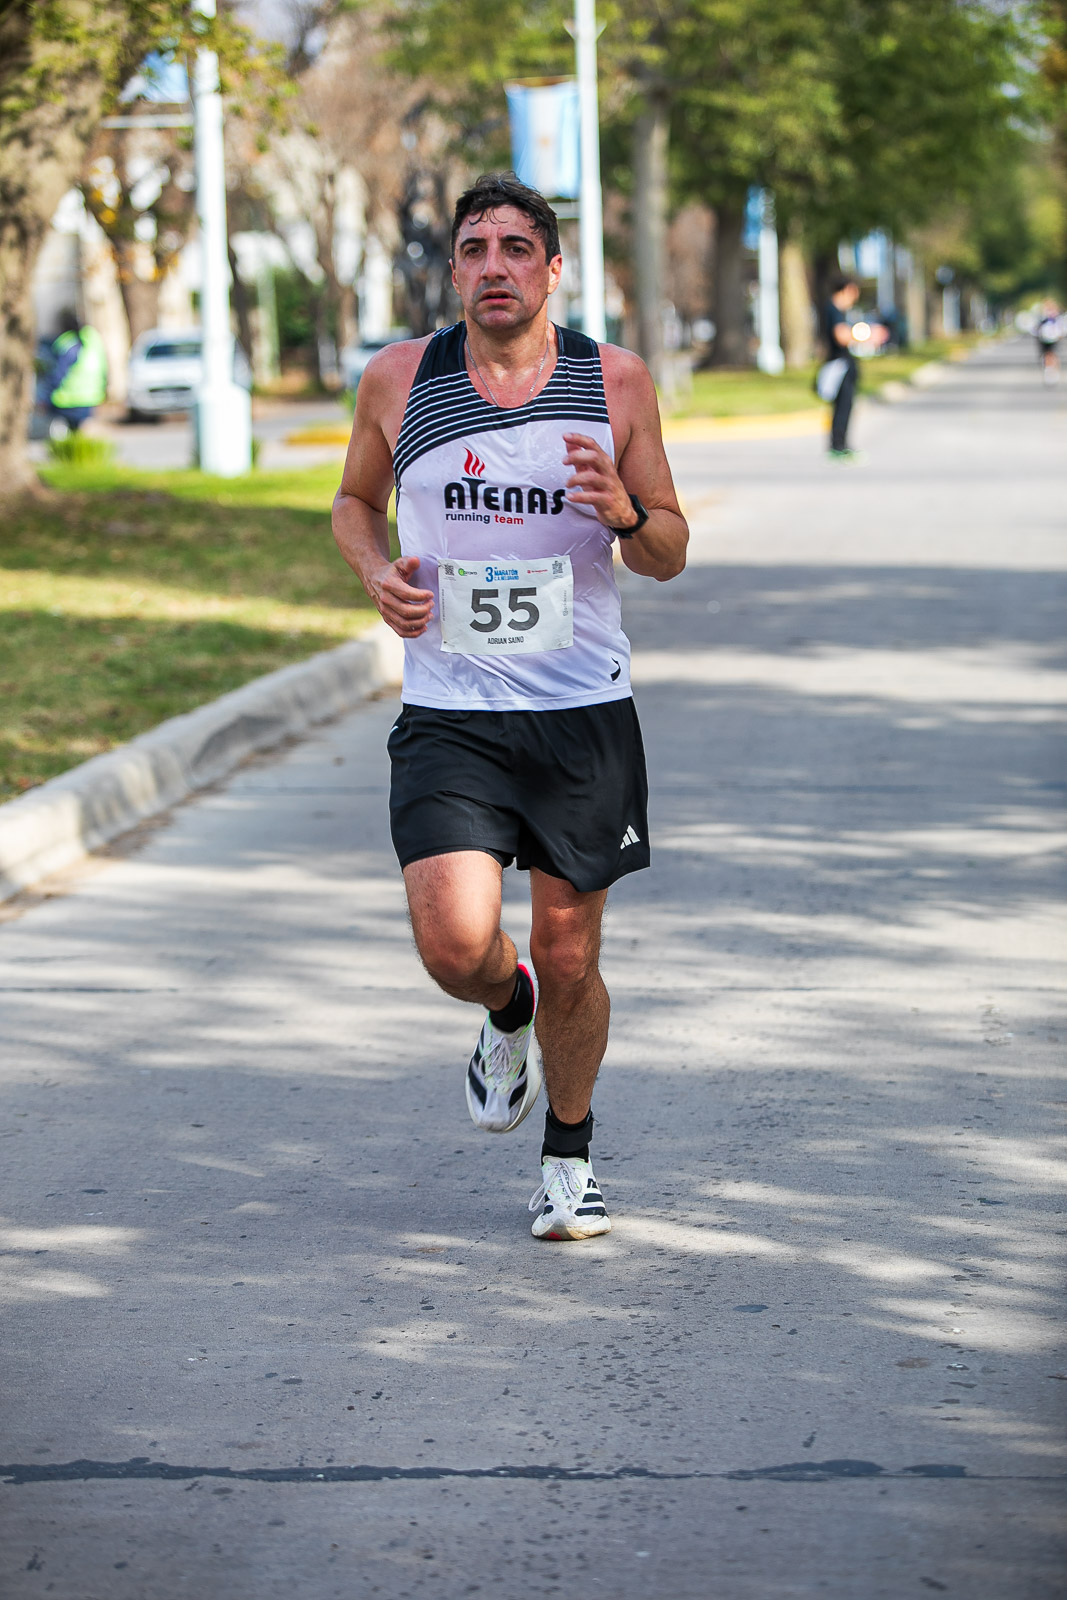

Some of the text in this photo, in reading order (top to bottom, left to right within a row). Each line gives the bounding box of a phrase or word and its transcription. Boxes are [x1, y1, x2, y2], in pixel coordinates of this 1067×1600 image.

[444, 476, 566, 515] ATENAS
[445, 512, 524, 525] running team
[469, 587, 540, 633] 55
[487, 637, 507, 645] ADRIAN
